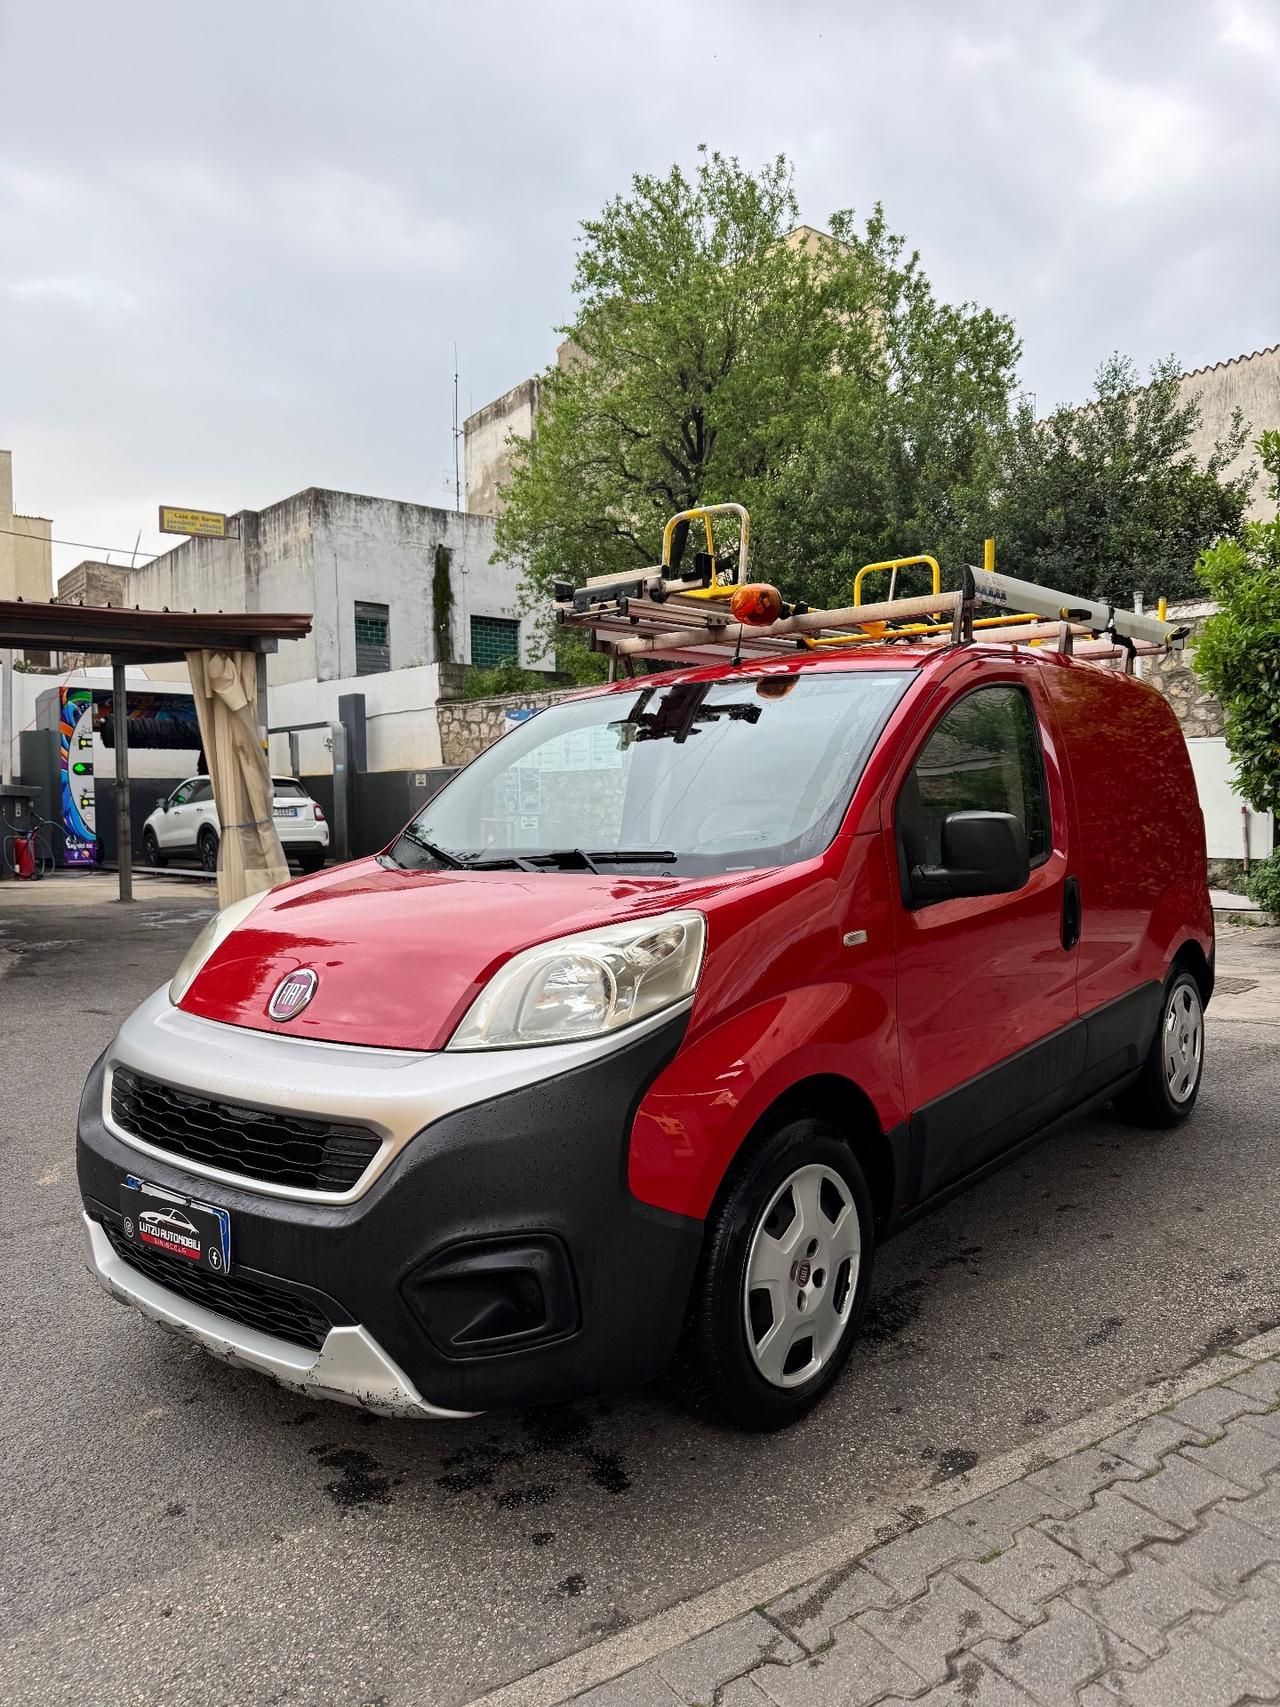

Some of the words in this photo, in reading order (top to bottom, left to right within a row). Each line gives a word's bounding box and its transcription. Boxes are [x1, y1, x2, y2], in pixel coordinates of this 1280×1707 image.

[277, 983, 307, 1006] FIAT
[139, 1221, 161, 1237] LUTZU
[160, 1230, 201, 1251] AUTOMOBILI
